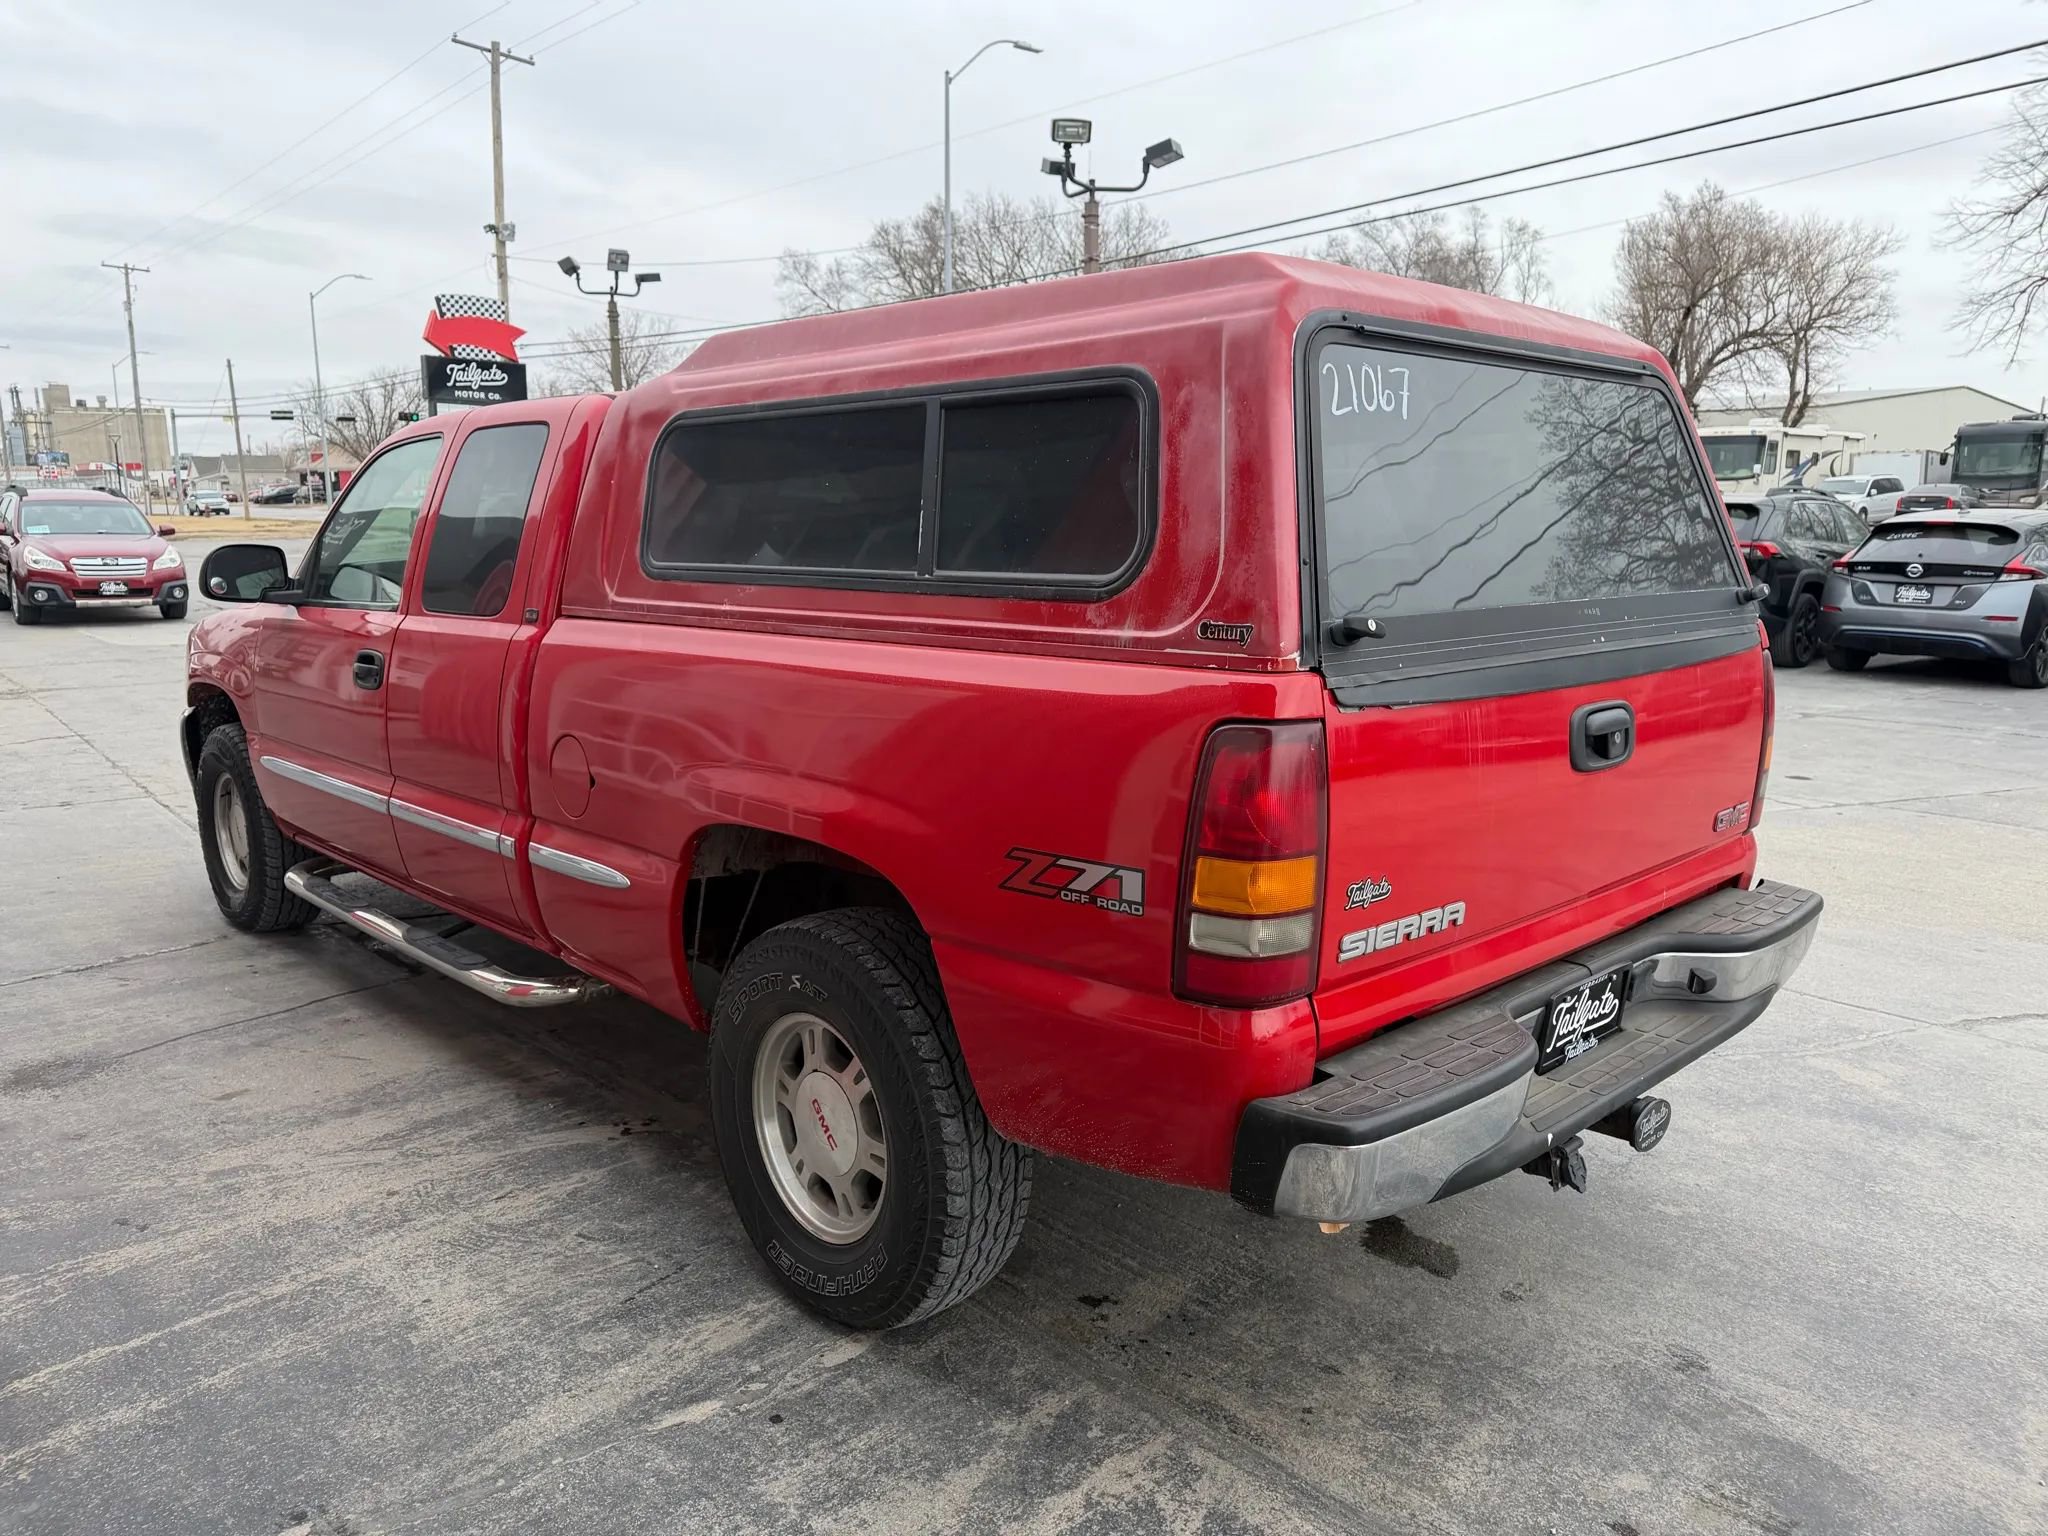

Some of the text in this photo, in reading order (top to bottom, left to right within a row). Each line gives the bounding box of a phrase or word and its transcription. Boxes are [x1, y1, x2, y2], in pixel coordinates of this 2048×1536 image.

[446, 362, 508, 390] Tailgate
[455, 390, 485, 400] MOTOR
[1322, 362, 1410, 420] 21067
[1198, 620, 1252, 645] Century
[999, 847, 1145, 903] Z71
[1345, 876, 1392, 910] Tailgate
[1060, 890, 1144, 916] OFF ROAD
[1338, 901, 1466, 962] SIERRA
[729, 972, 783, 1025] SPORT
[1546, 982, 1619, 1053] Tailgate
[1565, 1033, 1599, 1064] Tailgate
[812, 1098, 838, 1151] GMC
[1639, 1102, 1669, 1142] Tailgate
[766, 1240, 889, 1297] PATHFINDER
